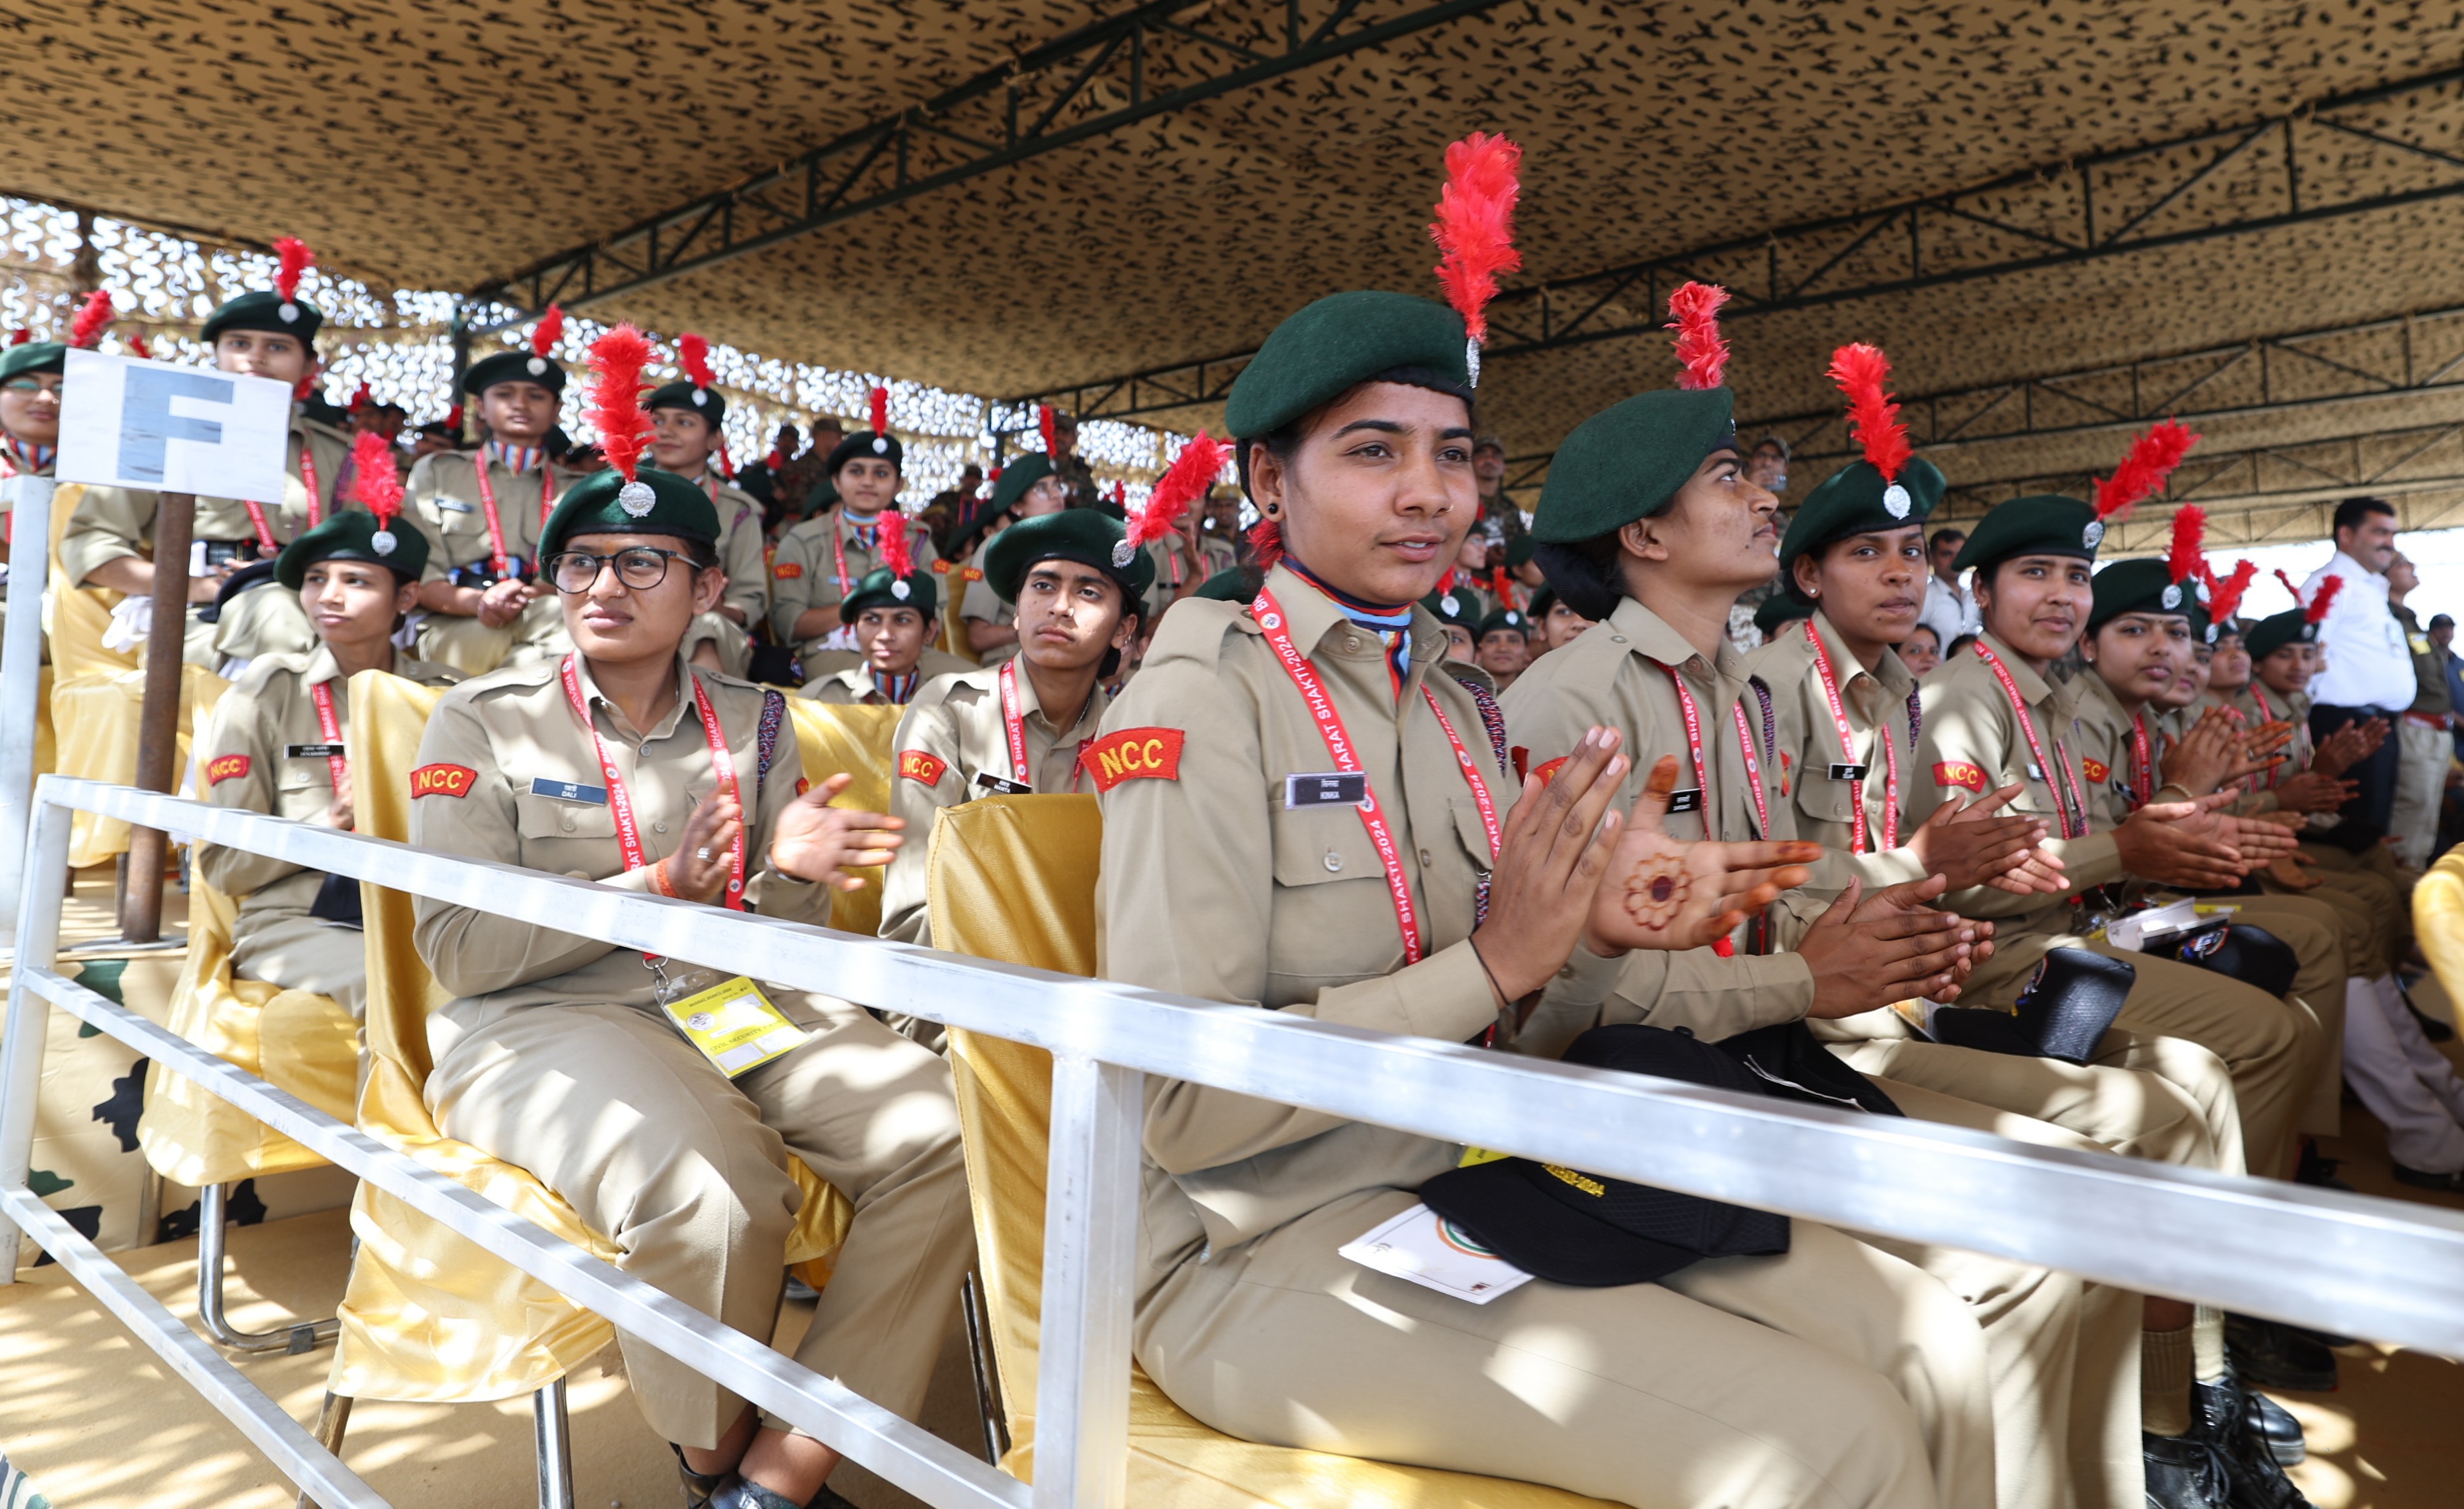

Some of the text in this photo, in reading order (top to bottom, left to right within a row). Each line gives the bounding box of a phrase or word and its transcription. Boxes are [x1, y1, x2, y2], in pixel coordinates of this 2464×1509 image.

[116, 365, 234, 484] F
[1273, 635, 1331, 720] SHAKTI-2024
[1823, 676, 1843, 716] BHARAT
[320, 707, 336, 738] BHARAT
[705, 712, 722, 747] BHARAT
[1682, 691, 1698, 741] BHARAT
[1734, 704, 1752, 753] BHARAT
[2018, 709, 2036, 743] BHARAT
[594, 732, 612, 764] BHARA
[1012, 721, 1022, 760] BHARAT
[210, 758, 241, 778] NCC
[903, 757, 933, 778] NCC
[1098, 739, 1163, 780] NCC
[1943, 766, 1978, 784] NCC
[2083, 762, 2102, 777] CC
[418, 769, 463, 790] NCC
[611, 784, 641, 870] RAT SHAKTI-2024
[1887, 802, 1896, 852] AKTI-2024
[1369, 819, 1418, 962] RAT SHAKTI-2024
[729, 1027, 762, 1045] SECURITY
